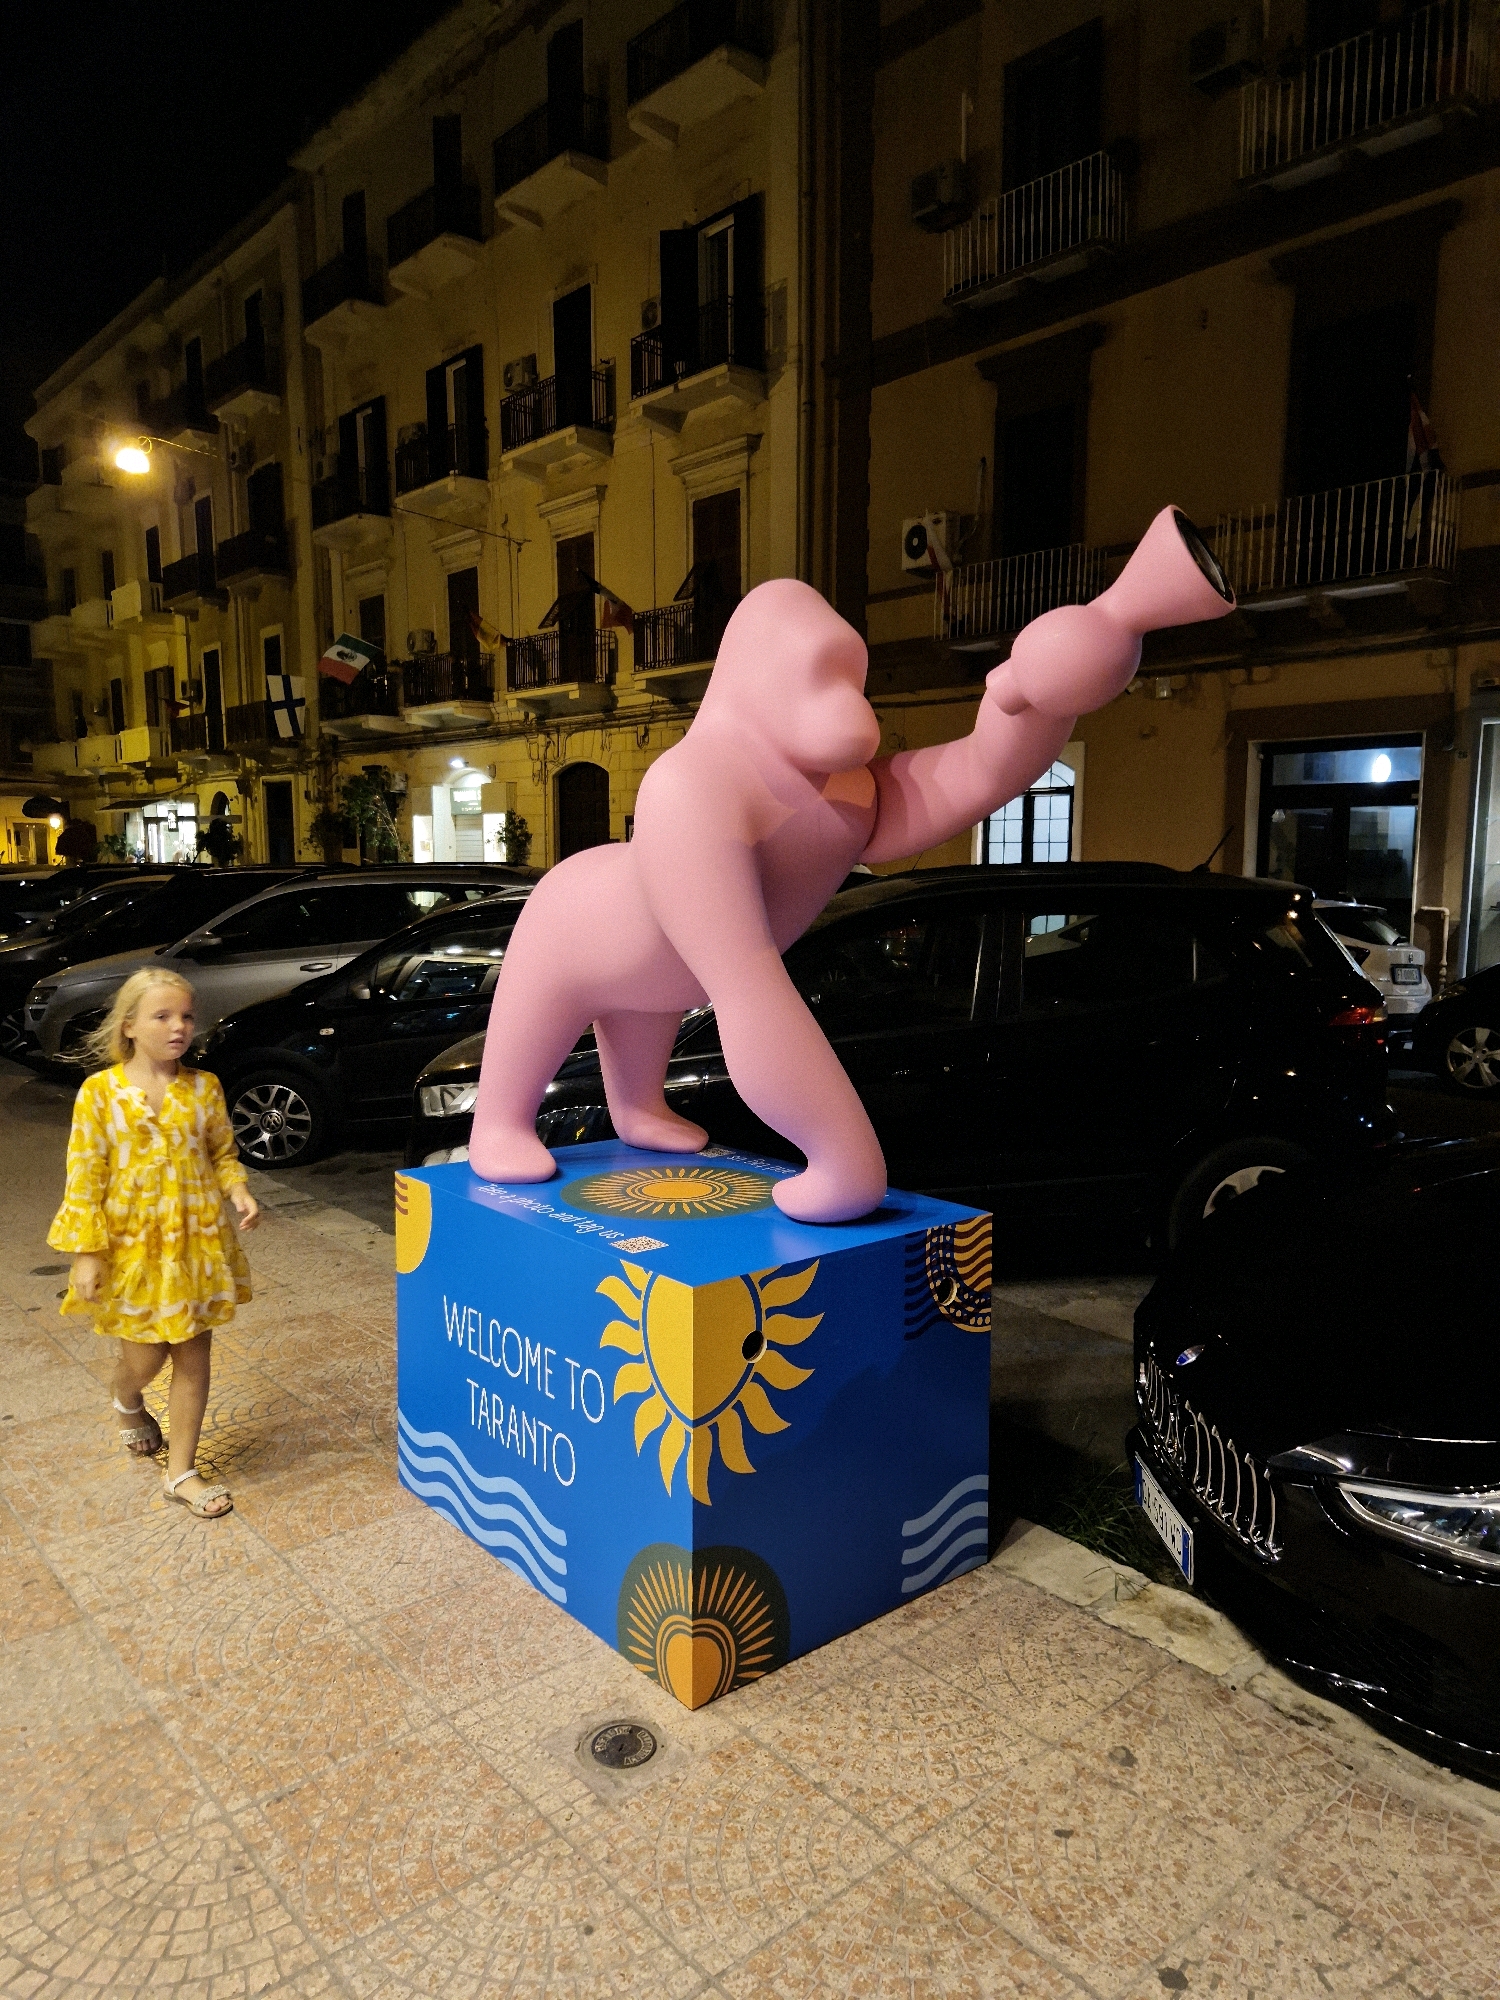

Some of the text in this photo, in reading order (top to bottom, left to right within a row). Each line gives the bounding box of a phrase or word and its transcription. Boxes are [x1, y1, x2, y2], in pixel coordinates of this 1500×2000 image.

[499, 1197, 555, 1214] photo
[548, 1212, 588, 1223] and
[573, 1219, 605, 1234] tag
[598, 1229, 625, 1239] us
[443, 1294, 605, 1424] WELCOME TO
[466, 1378, 576, 1487] TARANTO
